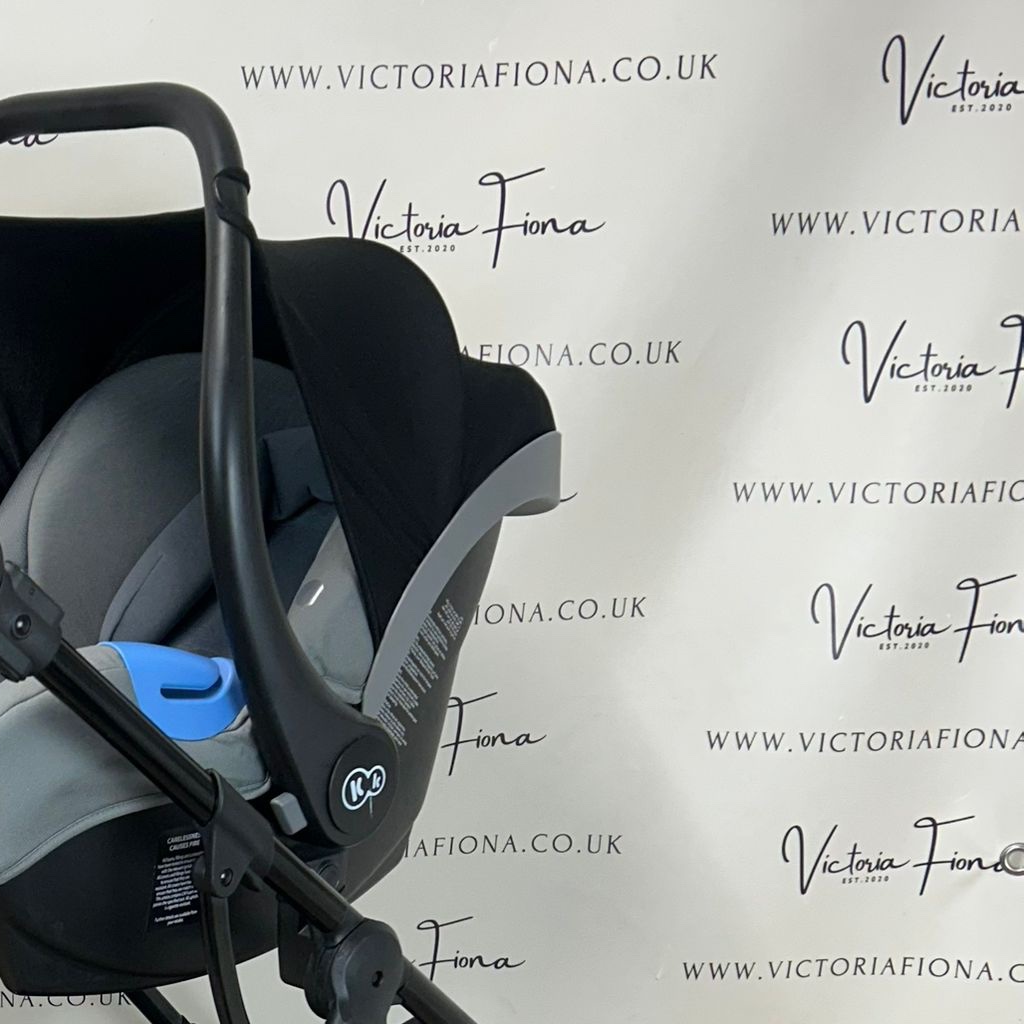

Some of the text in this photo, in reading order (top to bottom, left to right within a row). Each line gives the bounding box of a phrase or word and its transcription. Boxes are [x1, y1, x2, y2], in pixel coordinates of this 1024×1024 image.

[241, 52, 718, 92] WWW.VICTORIAFIONA.CO.UK
[882, 34, 1024, 125] Victoria
[952, 103, 1012, 113] EST.2020
[477, 168, 606, 269] Fiona
[771, 208, 1022, 237] WWW.VICTORIA
[842, 320, 995, 404] Victoria
[915, 383, 973, 393] EST.2020
[811, 583, 952, 661] Victoria
[879, 642, 930, 651] EST.2020
[781, 825, 911, 895] Victoria
[842, 875, 890, 884] EST.2020
